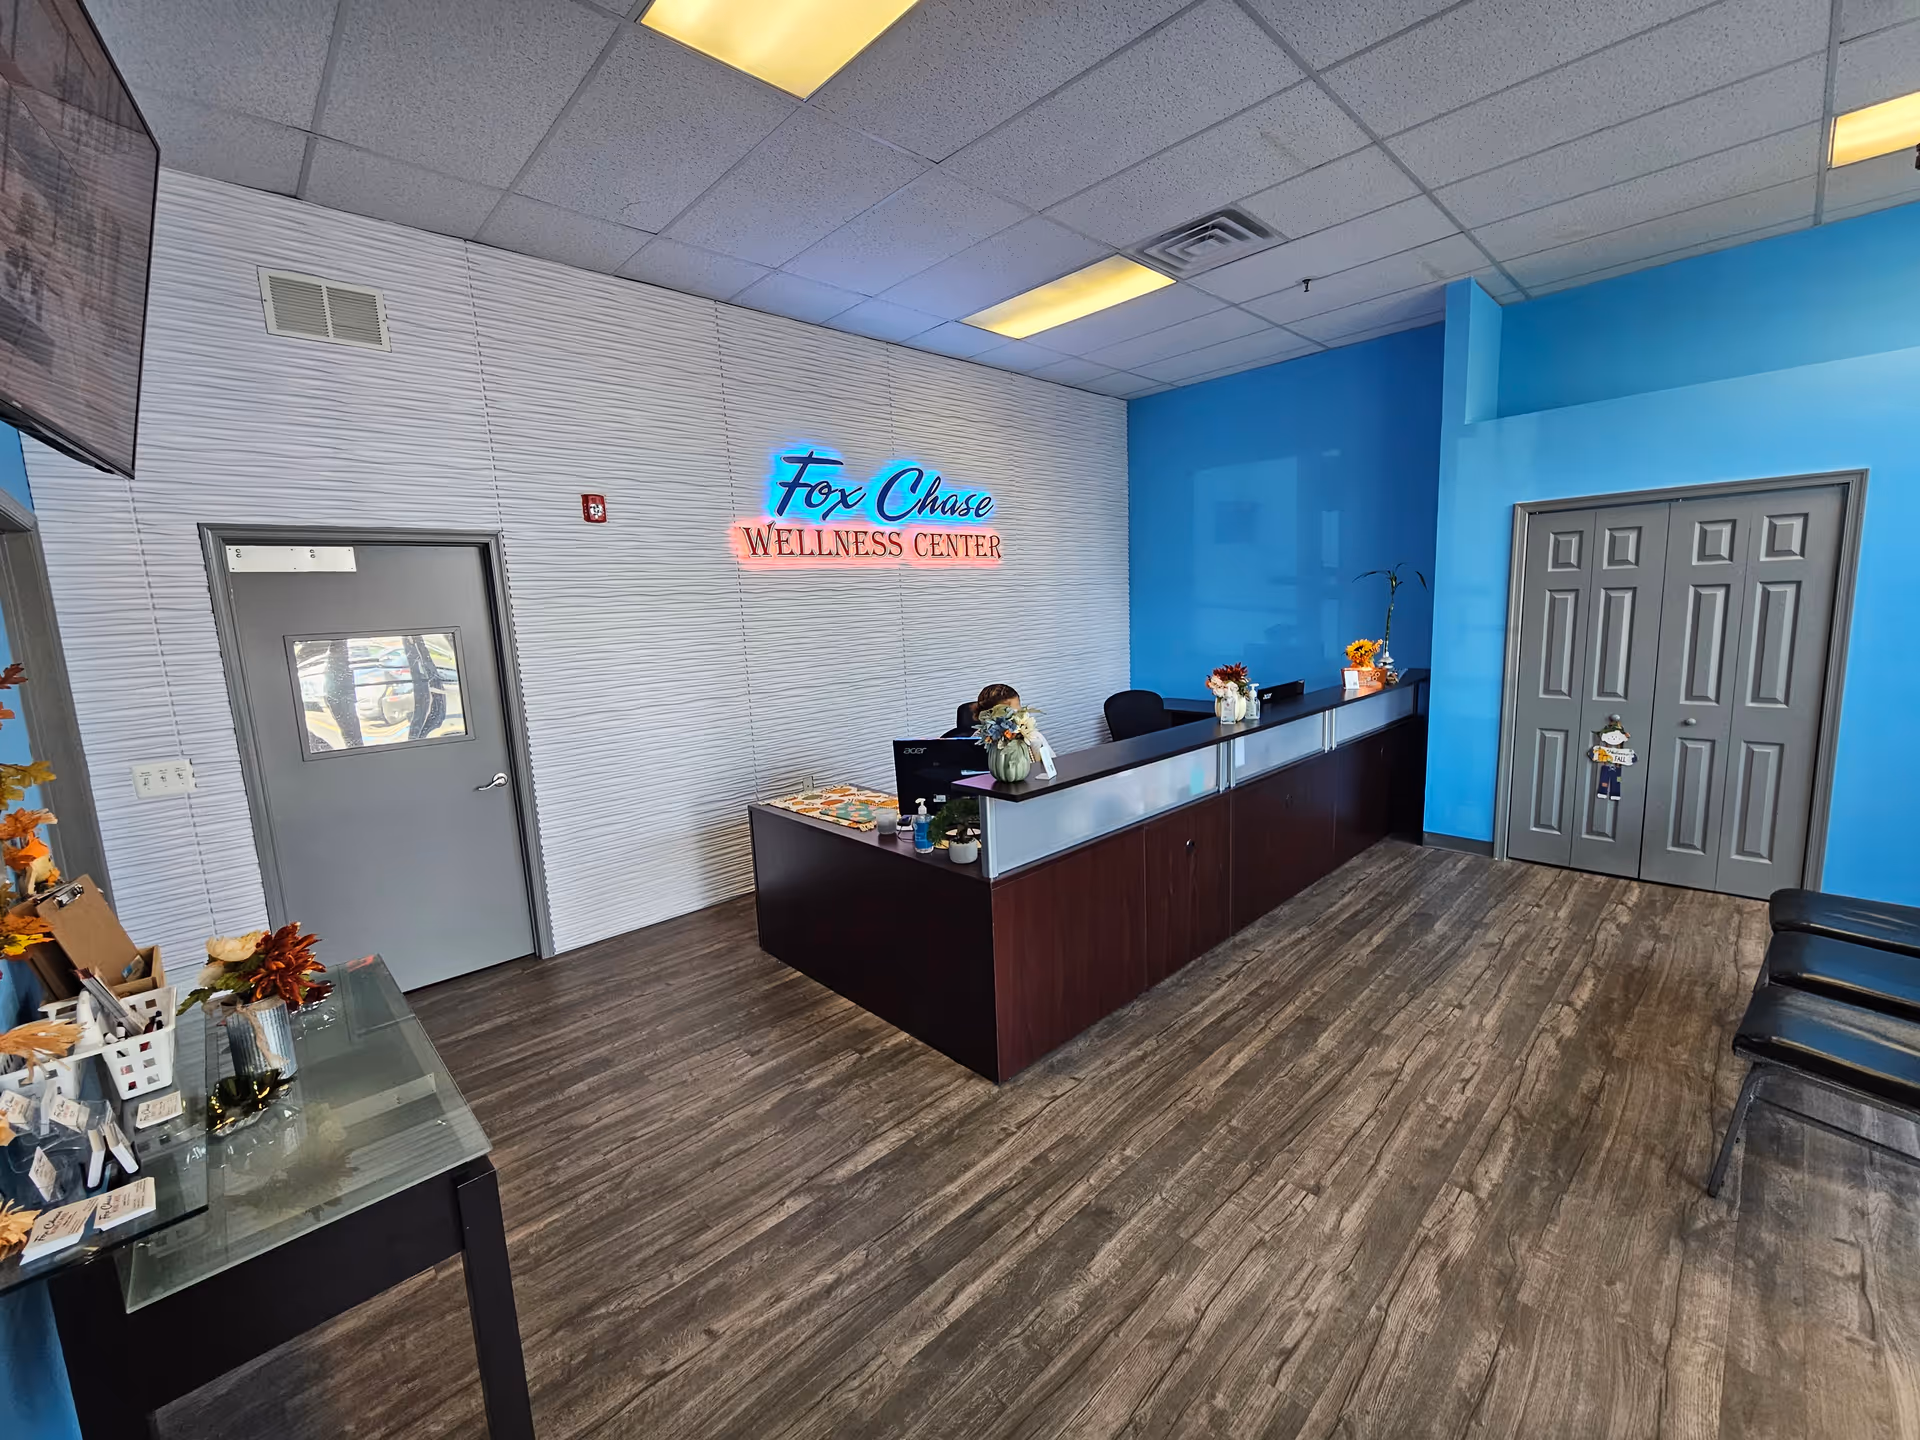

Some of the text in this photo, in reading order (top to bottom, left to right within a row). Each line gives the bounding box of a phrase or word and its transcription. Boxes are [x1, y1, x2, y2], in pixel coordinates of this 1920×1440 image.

[775, 450, 994, 522] Fox Chase
[743, 521, 1002, 559] WELLNESS CENTER
[903, 747, 928, 755] acer
